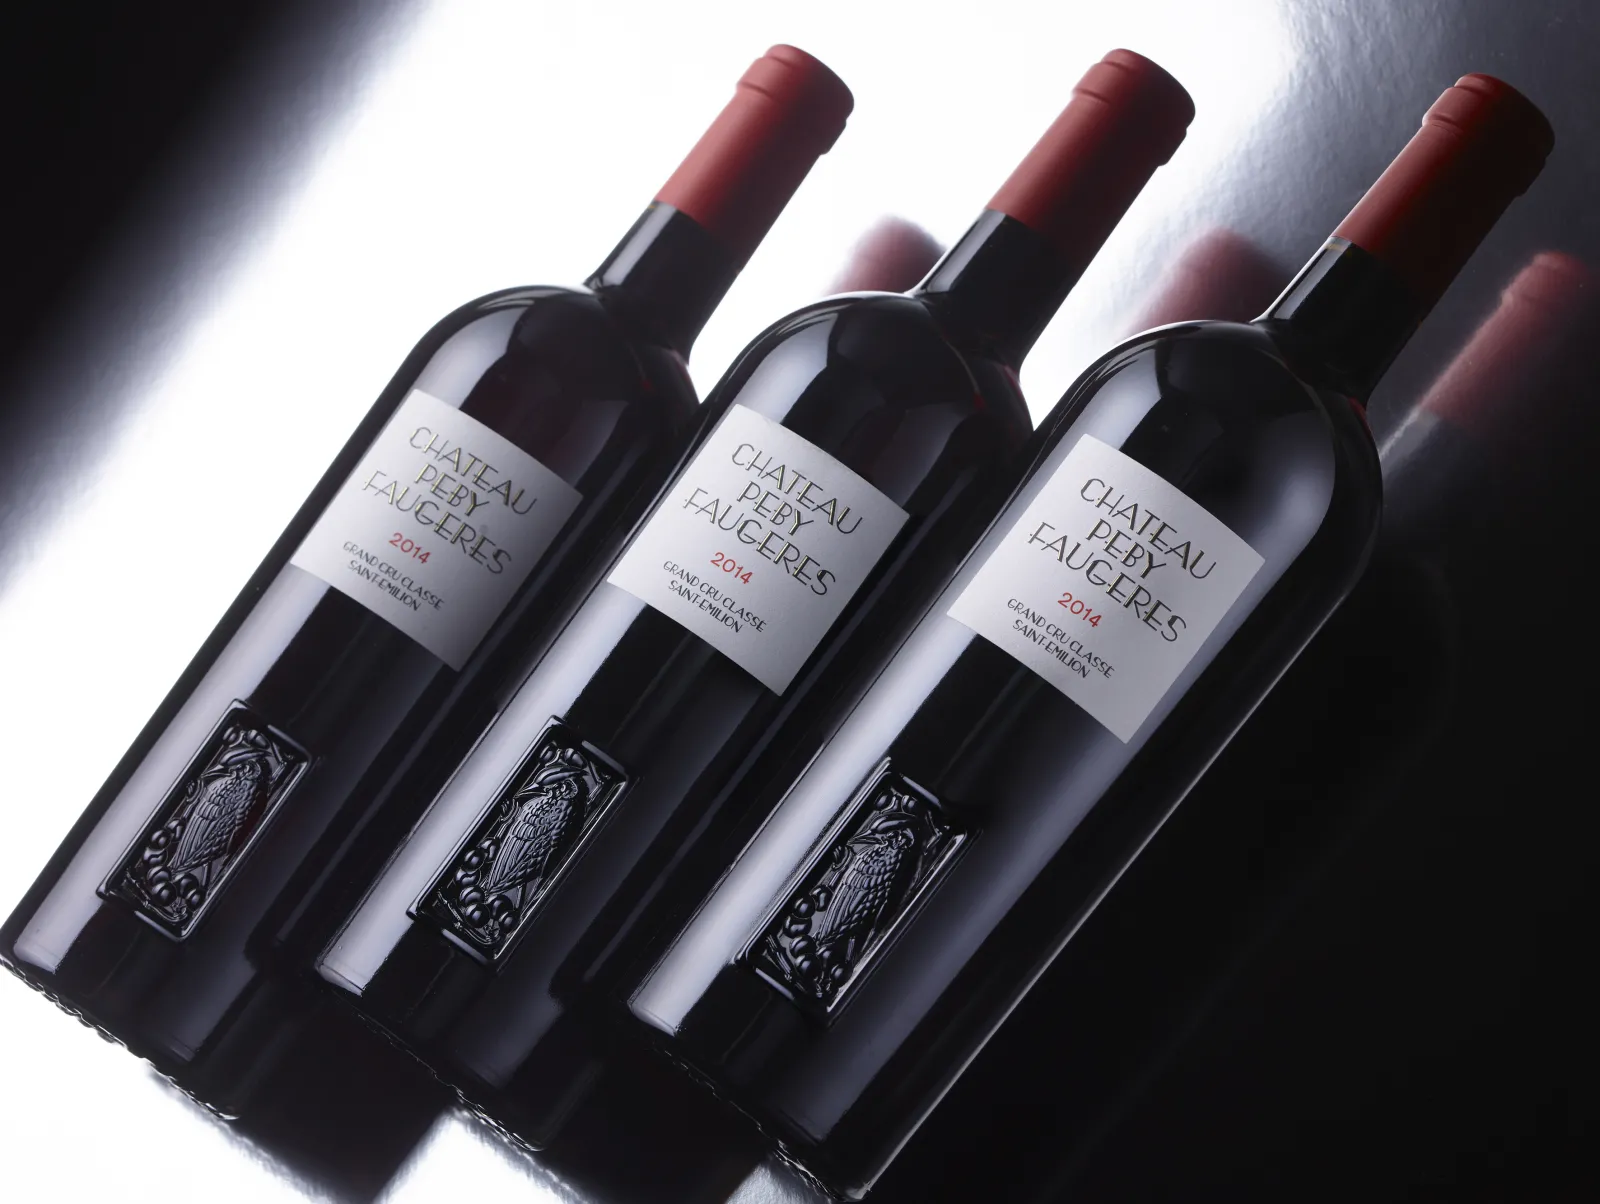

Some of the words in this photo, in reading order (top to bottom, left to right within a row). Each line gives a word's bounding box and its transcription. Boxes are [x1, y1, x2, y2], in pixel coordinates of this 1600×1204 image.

[409, 426, 538, 515] CHATEAU
[414, 463, 490, 517] PEBY
[731, 443, 863, 535] CHATEAU
[362, 470, 513, 575] FAUGERES
[682, 487, 836, 596] FAUGERES
[736, 481, 815, 536] PEBY
[1080, 478, 1217, 580] CHATEAU
[343, 541, 379, 567] GRAND
[378, 562, 403, 581] CRU
[401, 576, 445, 611] CLASSE
[389, 532, 432, 565] 2014
[710, 552, 753, 585] 2014
[1027, 521, 1187, 642] FAUGERES
[1085, 518, 1167, 580] PEBY
[347, 559, 422, 611] SAINT-EMILION
[663, 560, 700, 587] GRAND
[699, 582, 724, 602] CRU
[722, 597, 767, 633] CLASSE
[668, 579, 743, 633] SAINT-EMILION
[1057, 592, 1102, 628] 2014
[1007, 598, 1047, 628] GRAND
[1045, 623, 1071, 645] CRU
[1069, 640, 1115, 679] CLASSE
[1012, 619, 1091, 679] SAINT-EMILION
